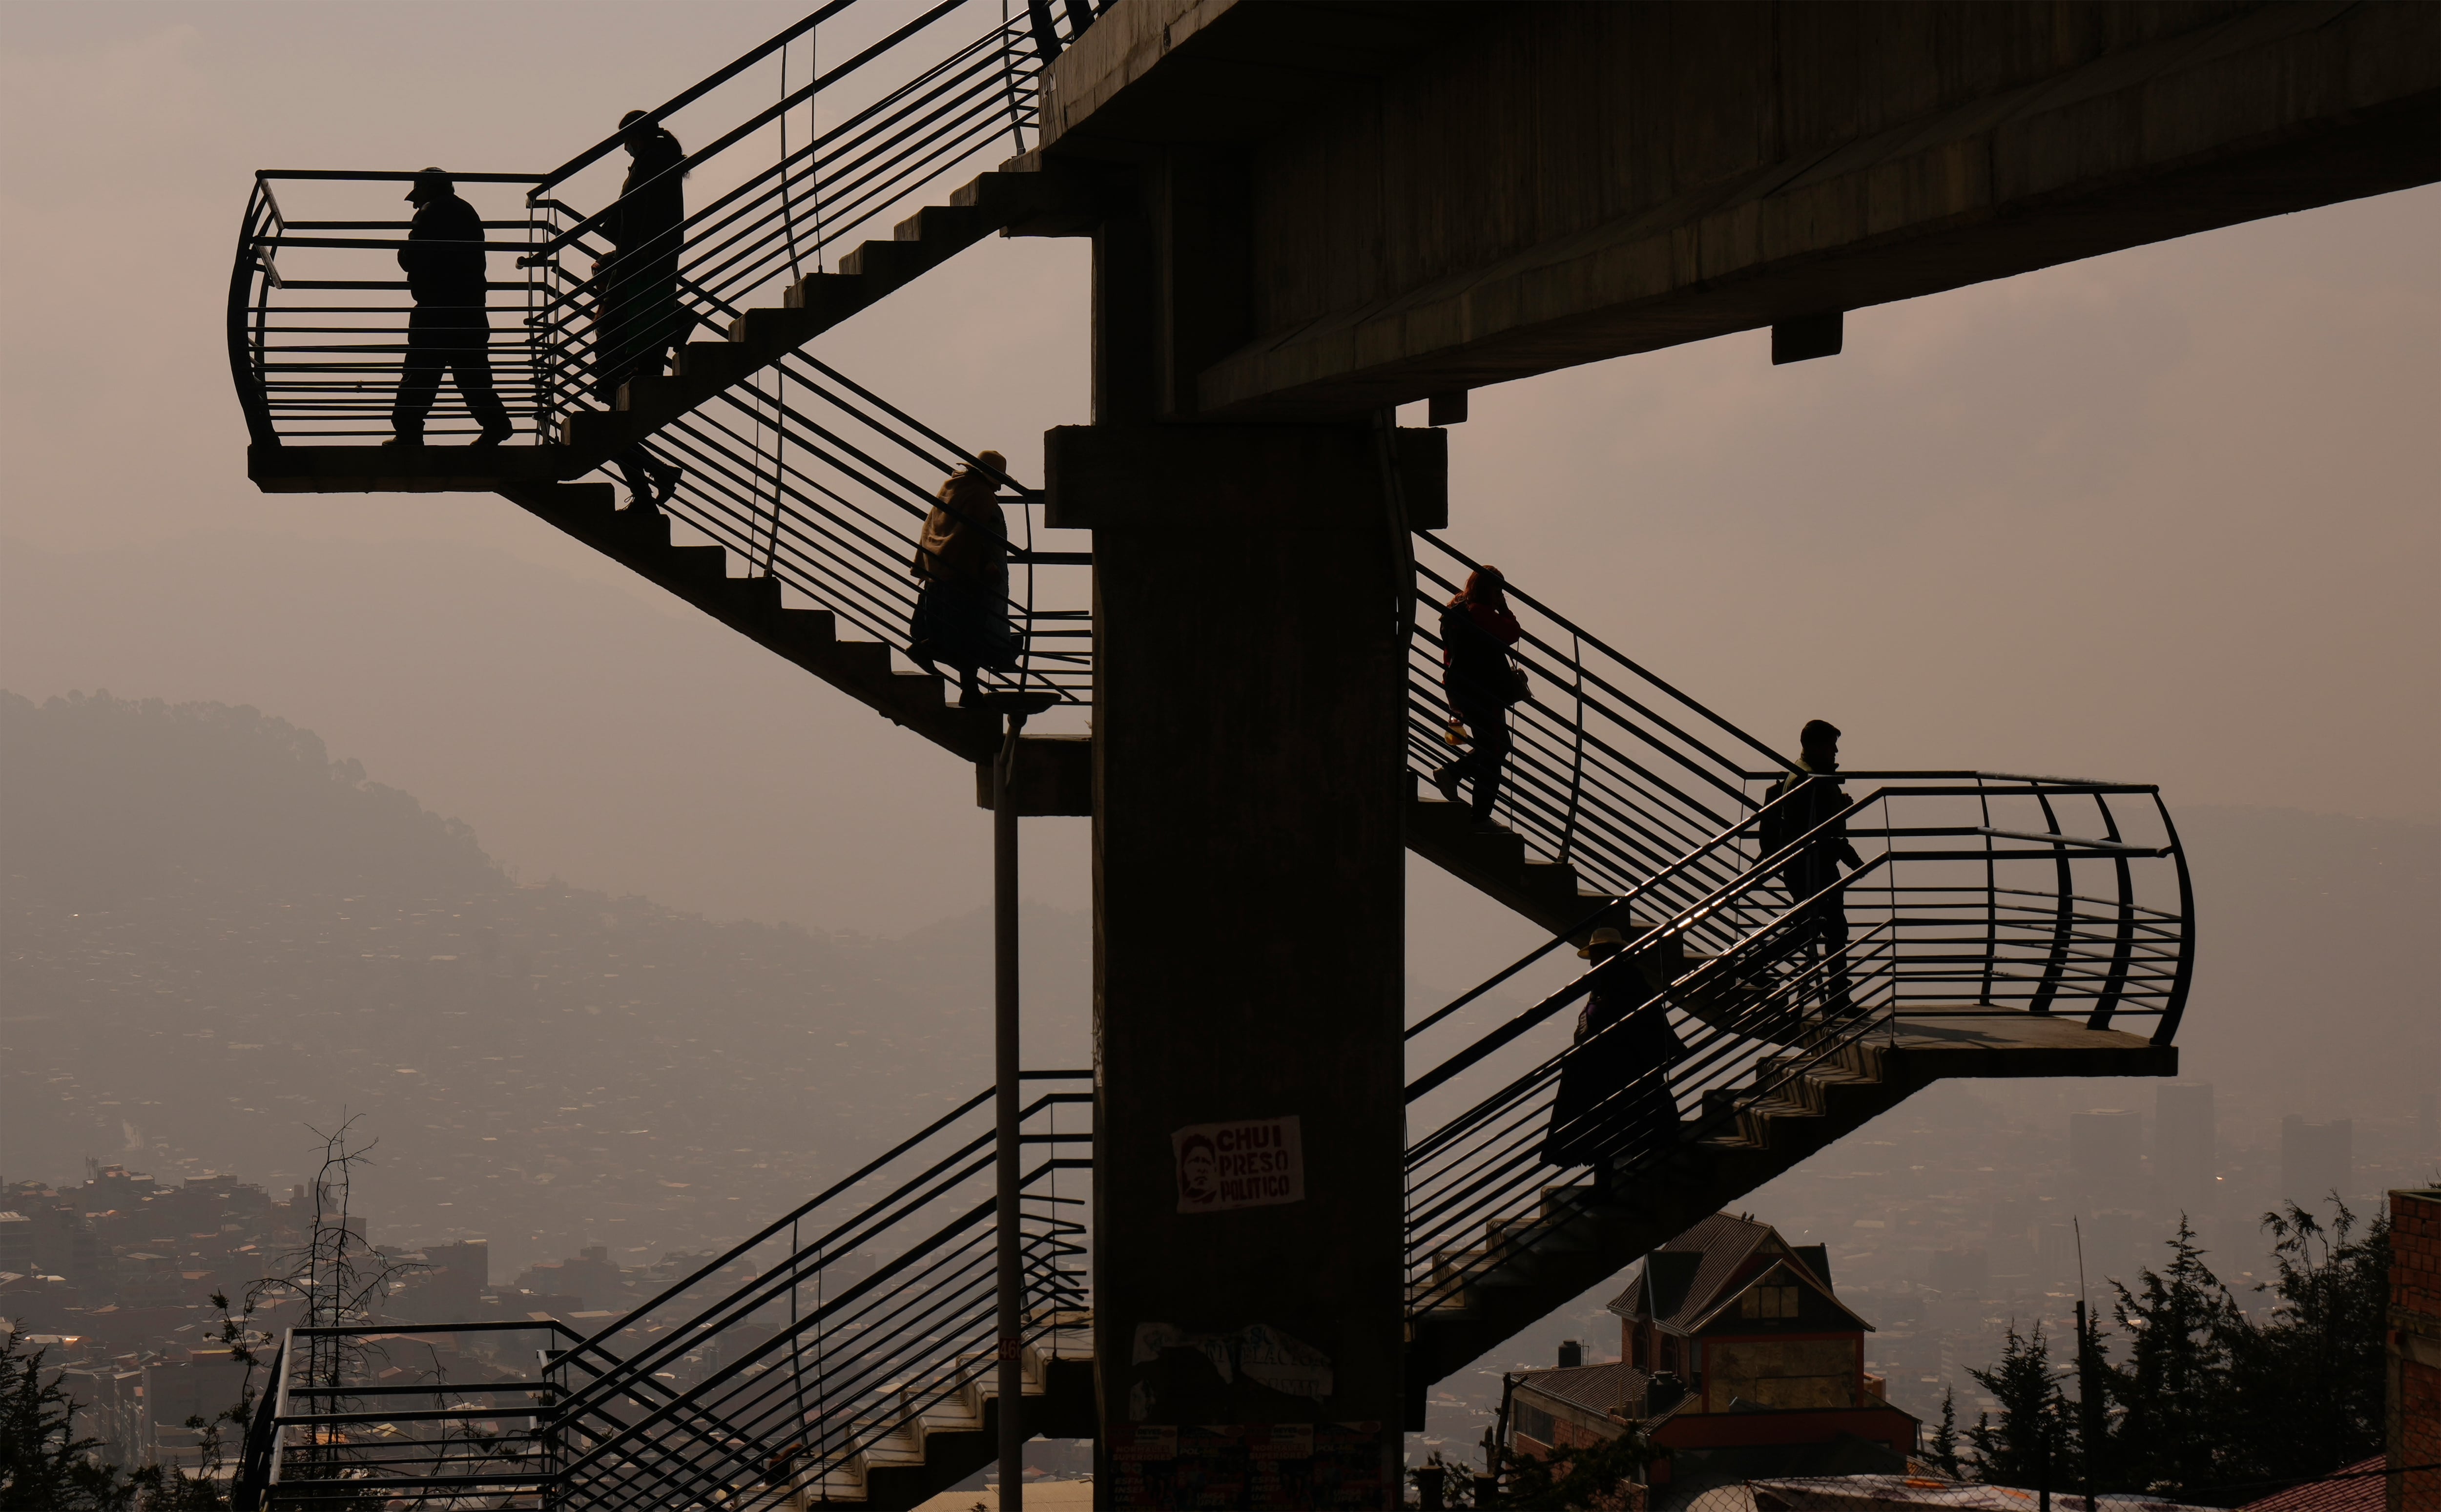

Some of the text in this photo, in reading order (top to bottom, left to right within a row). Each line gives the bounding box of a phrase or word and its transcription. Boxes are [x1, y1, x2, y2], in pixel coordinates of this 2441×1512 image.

[1217, 1125, 1282, 1152] CHUI
[1219, 1150, 1288, 1177] PRESO
[1220, 1175, 1289, 1201] POLITICO
